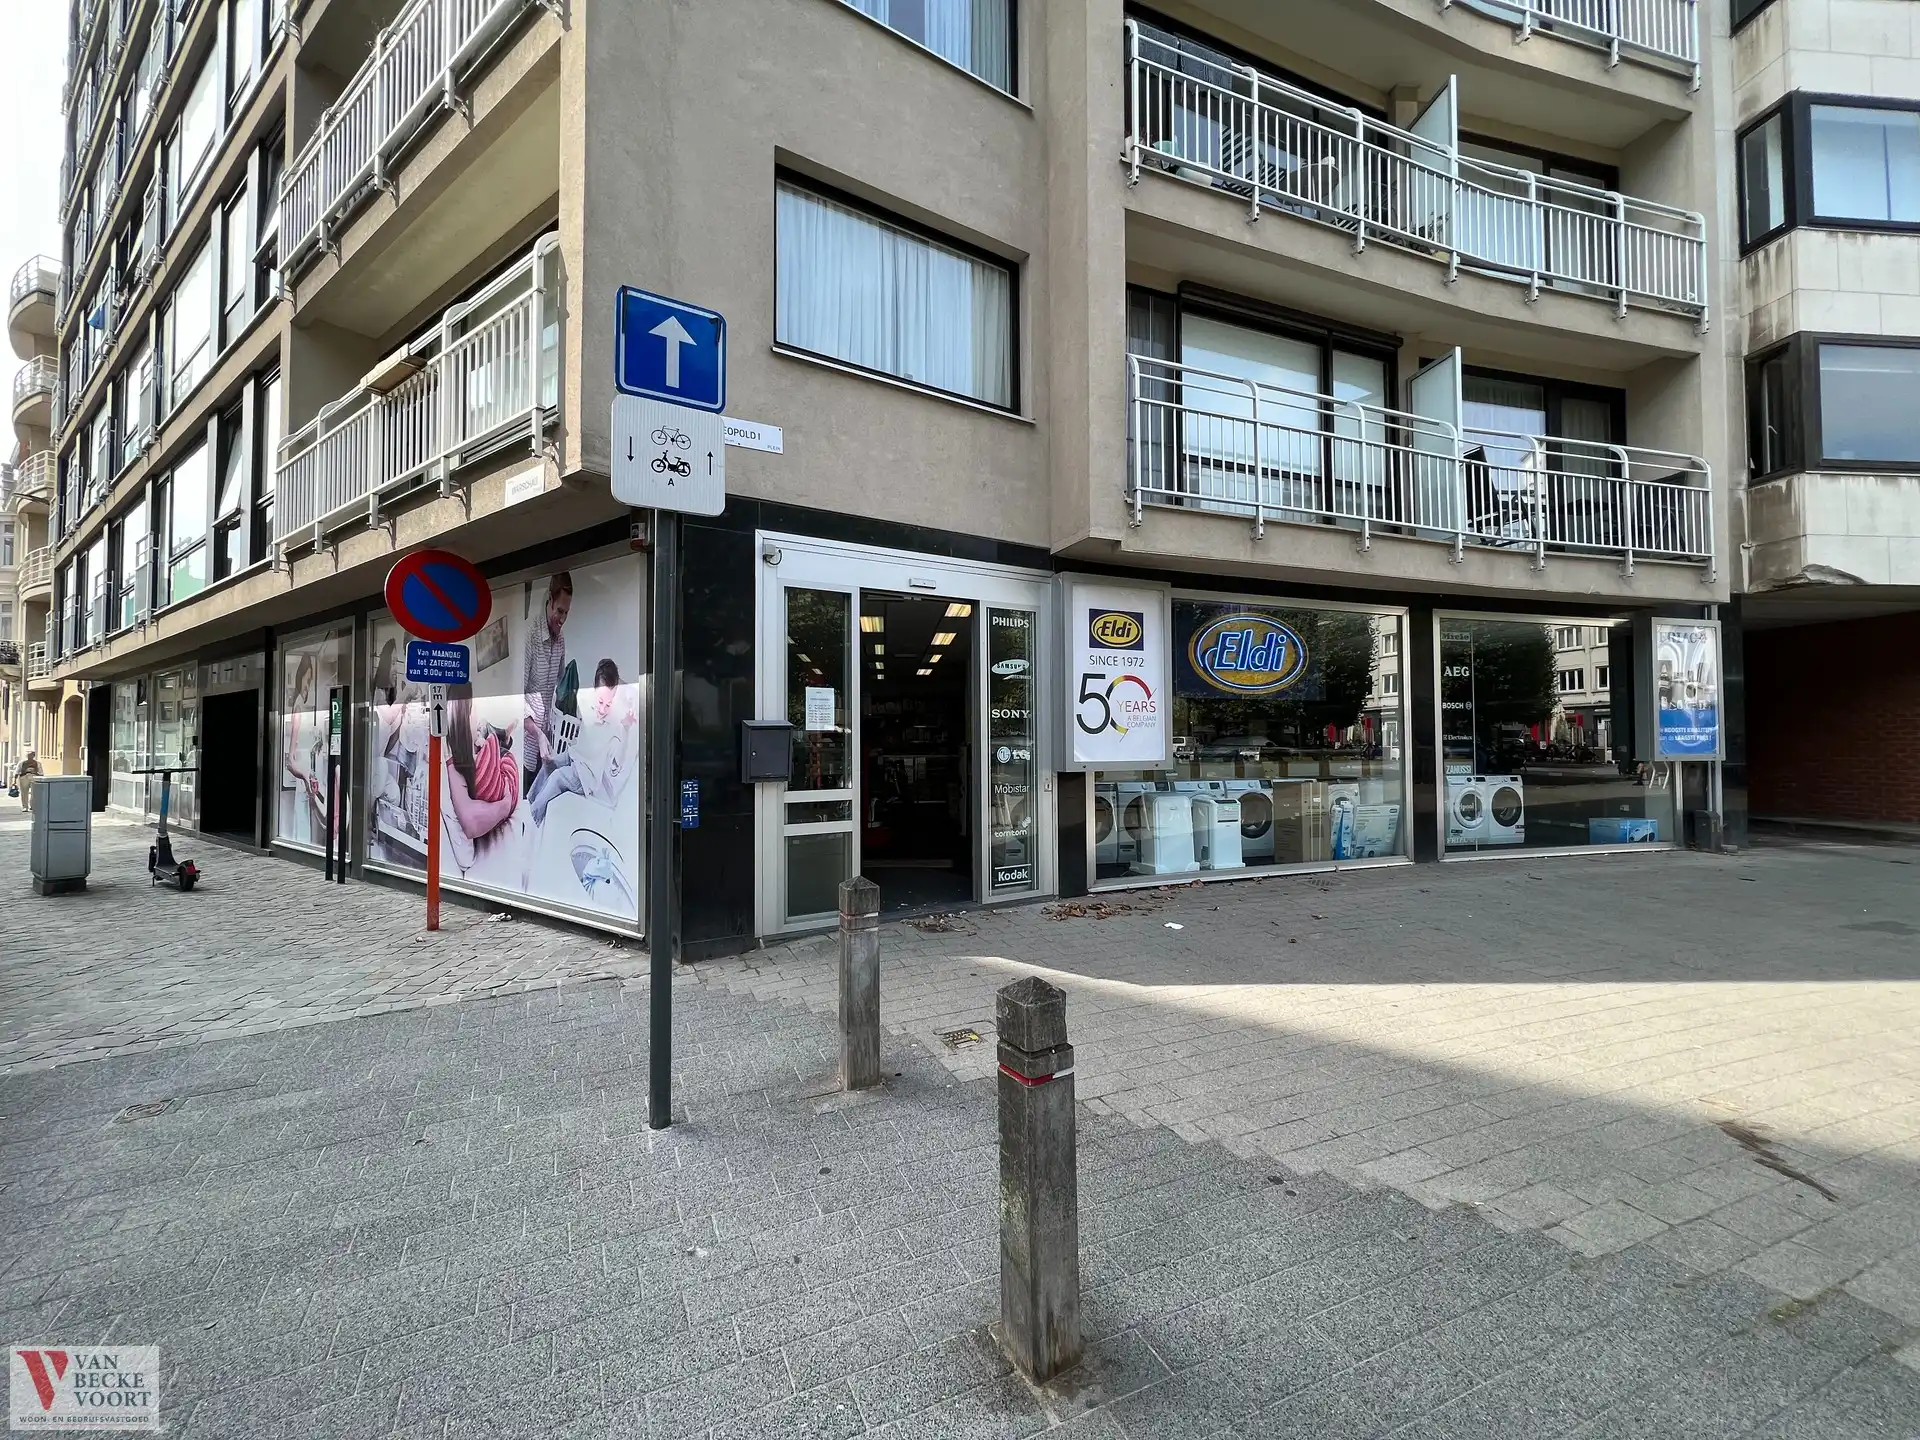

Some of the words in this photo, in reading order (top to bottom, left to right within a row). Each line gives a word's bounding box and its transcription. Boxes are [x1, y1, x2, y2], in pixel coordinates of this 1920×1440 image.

[724, 425, 756, 440] EOPOLD
[667, 477, 675, 487] A
[992, 616, 1030, 629] PHILIPS
[1096, 620, 1133, 638] Eldi
[417, 648, 429, 656] Van
[431, 649, 461, 659] MAANDAG
[1205, 629, 1287, 671] Eldi
[417, 658, 427, 666] tot
[429, 659, 460, 668] ZATERDAG
[1089, 655, 1119, 667] SINCE
[1121, 656, 1145, 667] 1972
[1443, 666, 1470, 677] AEG
[432, 685, 442, 693] 17
[1115, 699, 1157, 714] YEARS
[991, 708, 1030, 719] SONY
[998, 868, 1028, 882] Kodak
